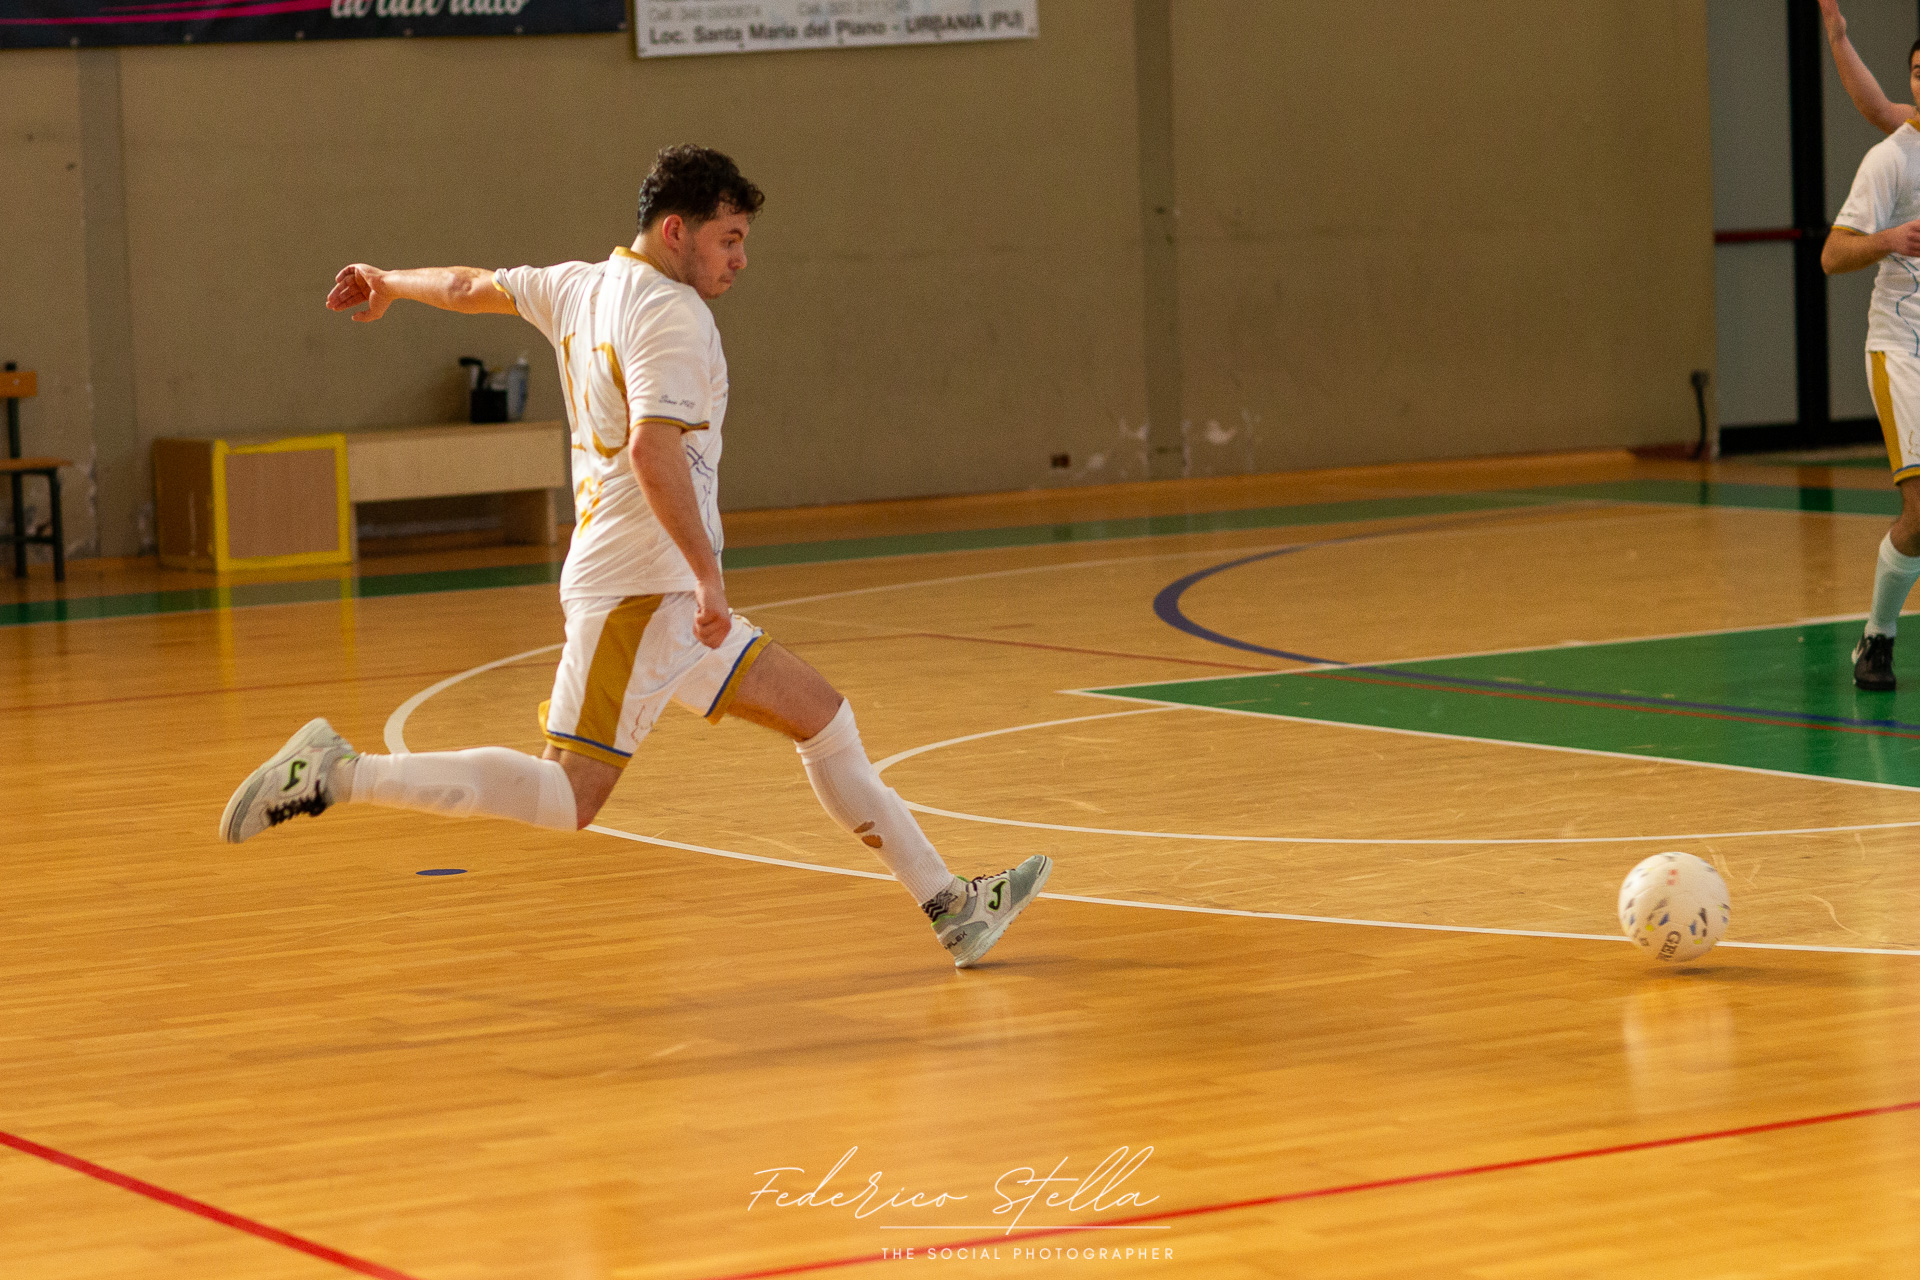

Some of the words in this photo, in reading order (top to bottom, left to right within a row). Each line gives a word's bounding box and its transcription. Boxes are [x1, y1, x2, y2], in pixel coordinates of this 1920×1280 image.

[650, 27, 685, 45] Loc.
[694, 25, 742, 43] Santa
[750, 23, 798, 40] Maria
[836, 19, 887, 36] Piano
